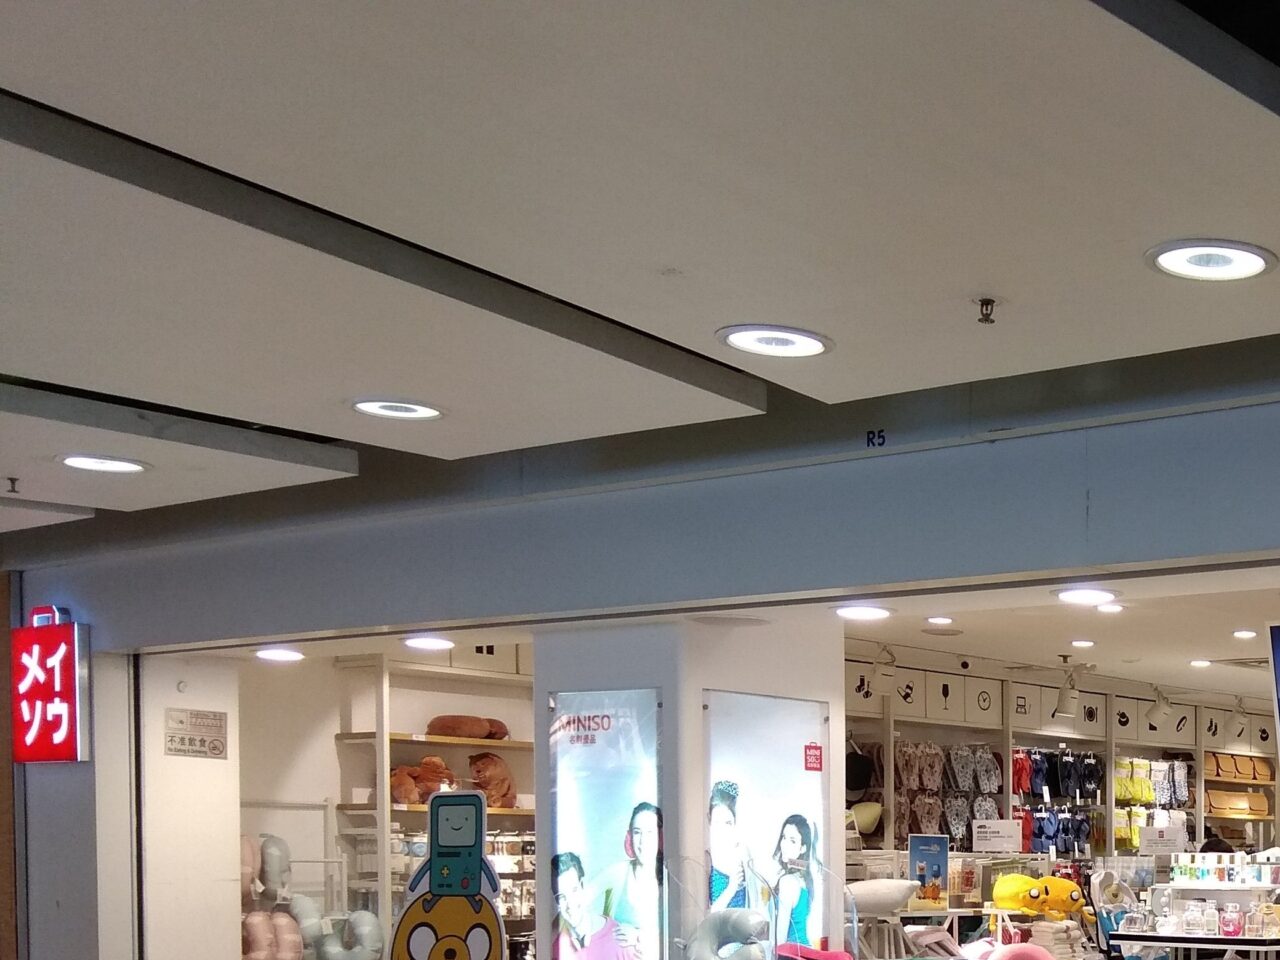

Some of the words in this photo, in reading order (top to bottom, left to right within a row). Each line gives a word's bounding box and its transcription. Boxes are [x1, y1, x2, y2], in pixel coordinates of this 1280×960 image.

[866, 429, 886, 448] R5
[18, 641, 68, 694] メイ
[20, 696, 69, 747] ソウ
